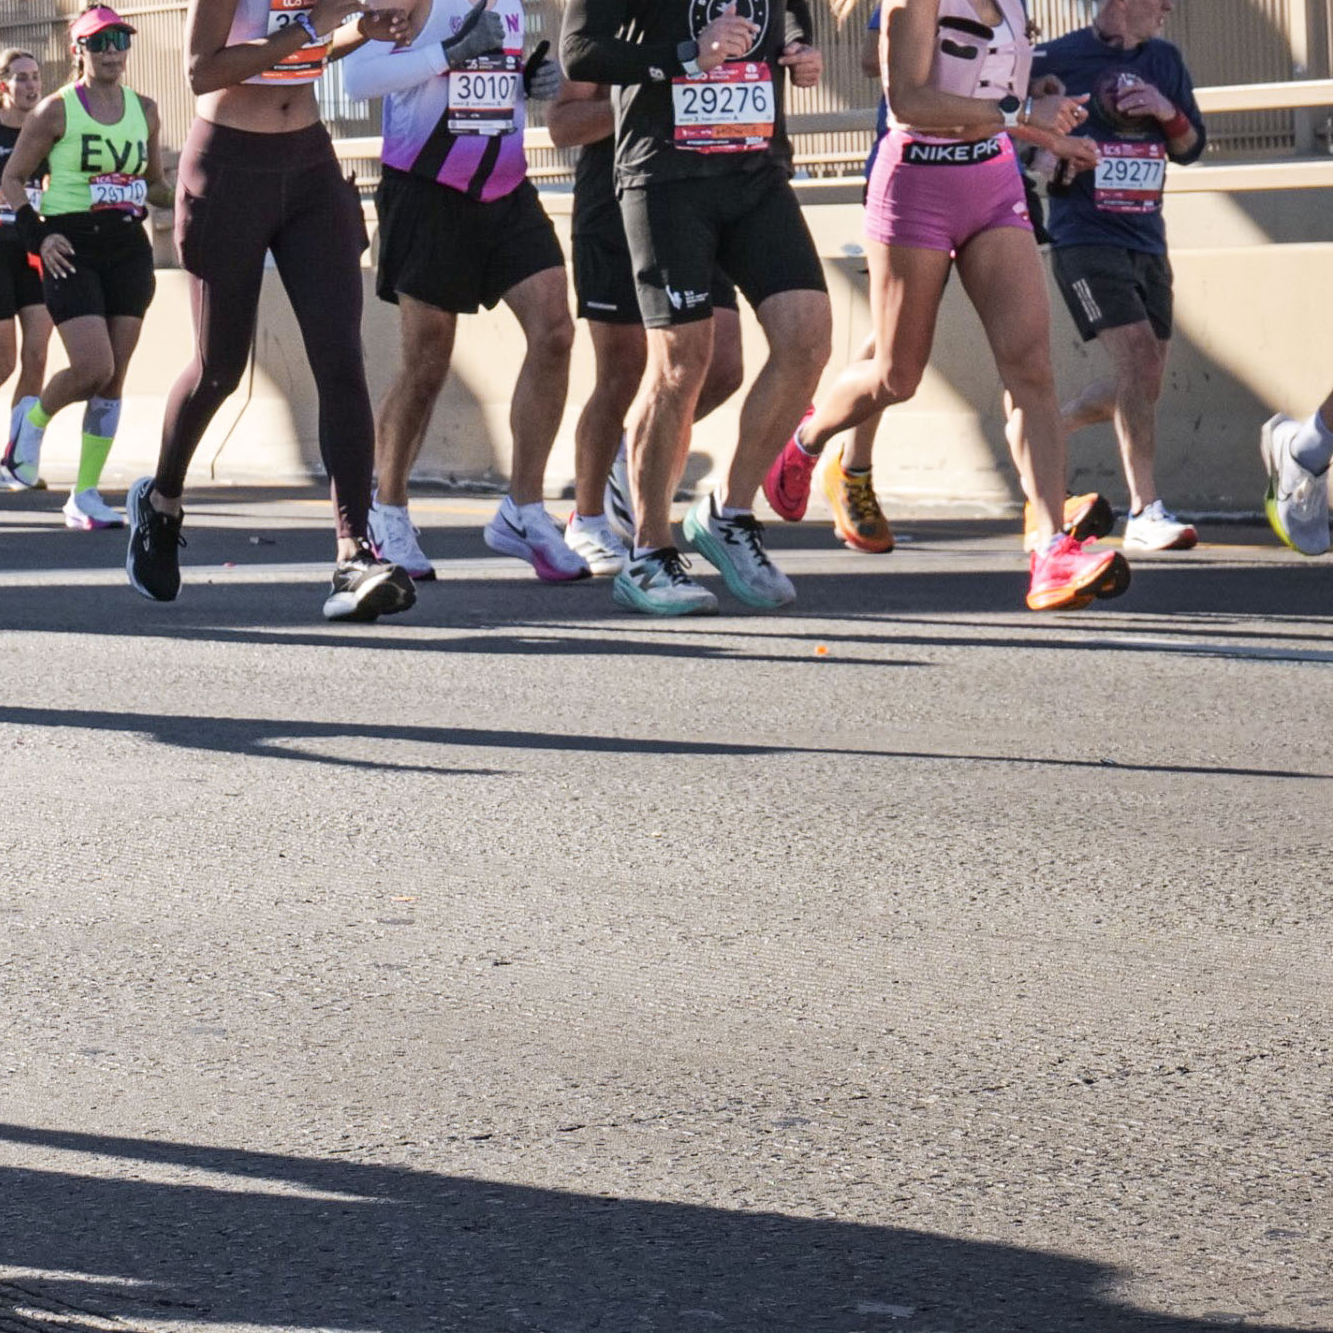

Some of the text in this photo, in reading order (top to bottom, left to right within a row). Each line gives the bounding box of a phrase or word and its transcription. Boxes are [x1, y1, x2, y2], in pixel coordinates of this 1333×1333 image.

[457, 74, 518, 100] 30107
[681, 85, 767, 115] 29276
[910, 139, 999, 161] NIKE PR
[1101, 159, 1161, 182] 29277
